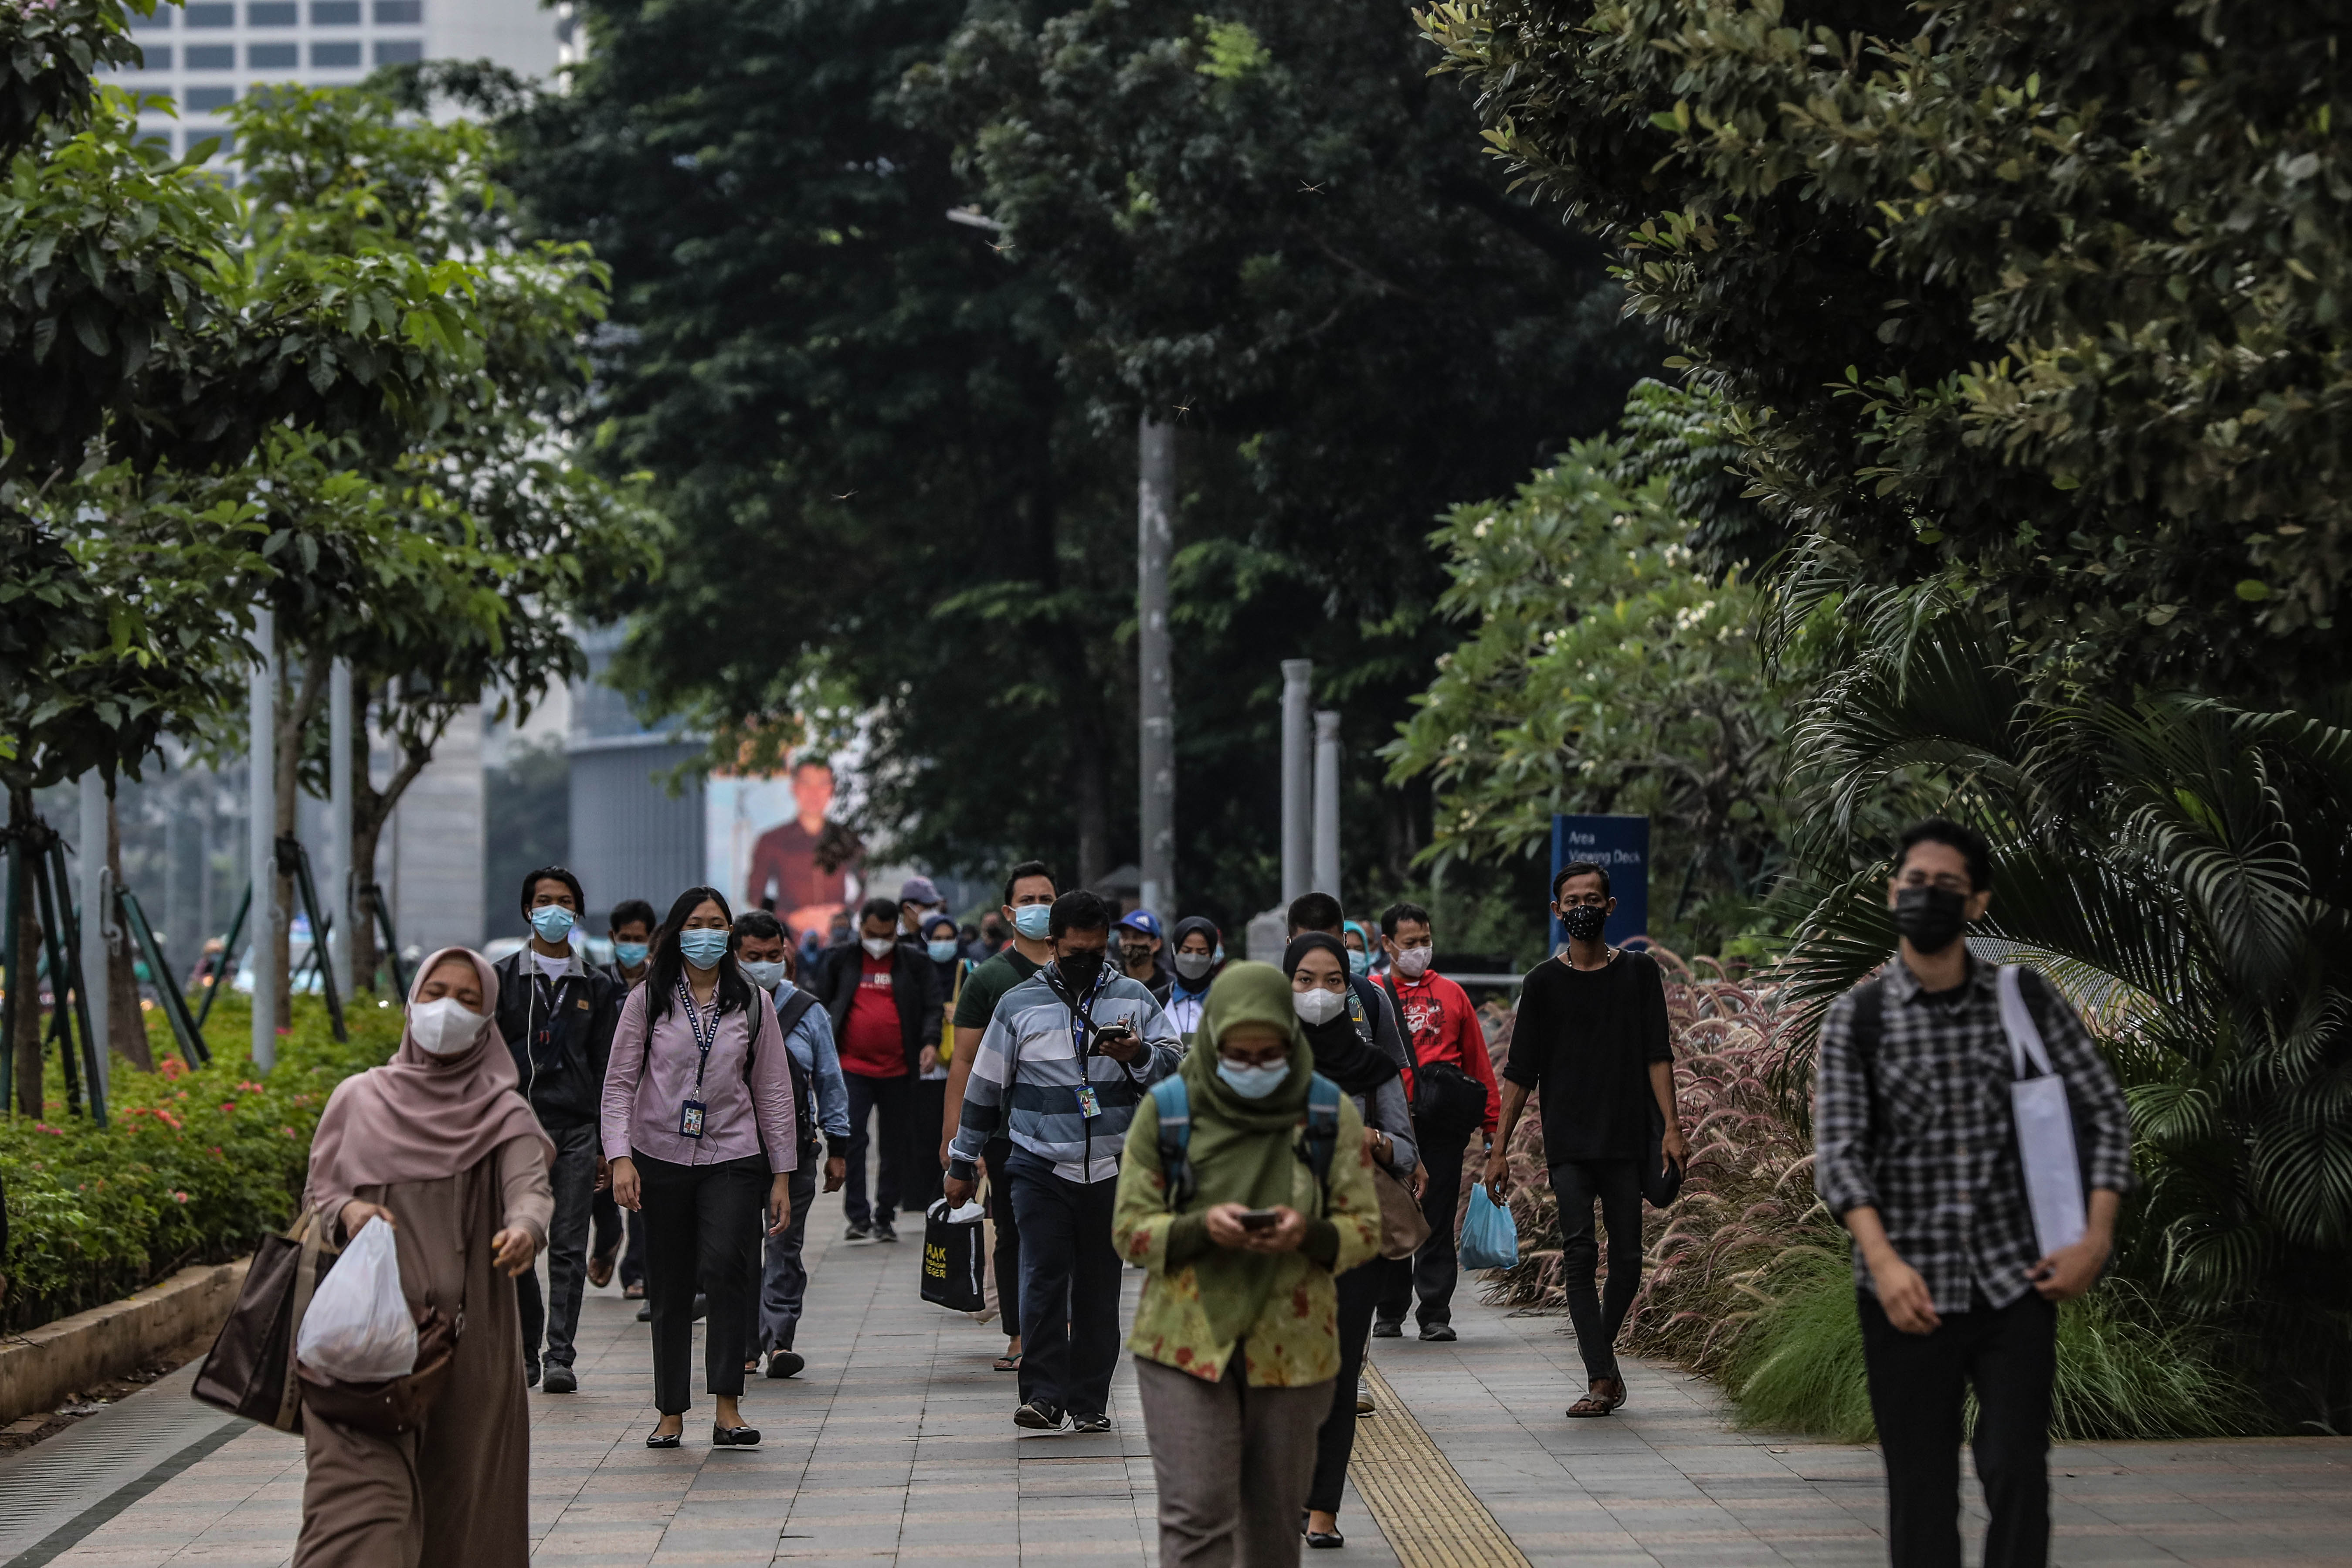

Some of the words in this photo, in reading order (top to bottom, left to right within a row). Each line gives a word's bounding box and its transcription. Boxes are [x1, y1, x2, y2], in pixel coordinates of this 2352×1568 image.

[1568, 830, 1595, 845] Area
[1568, 848, 1611, 867] Viewing
[1613, 848, 1641, 864] Deck
